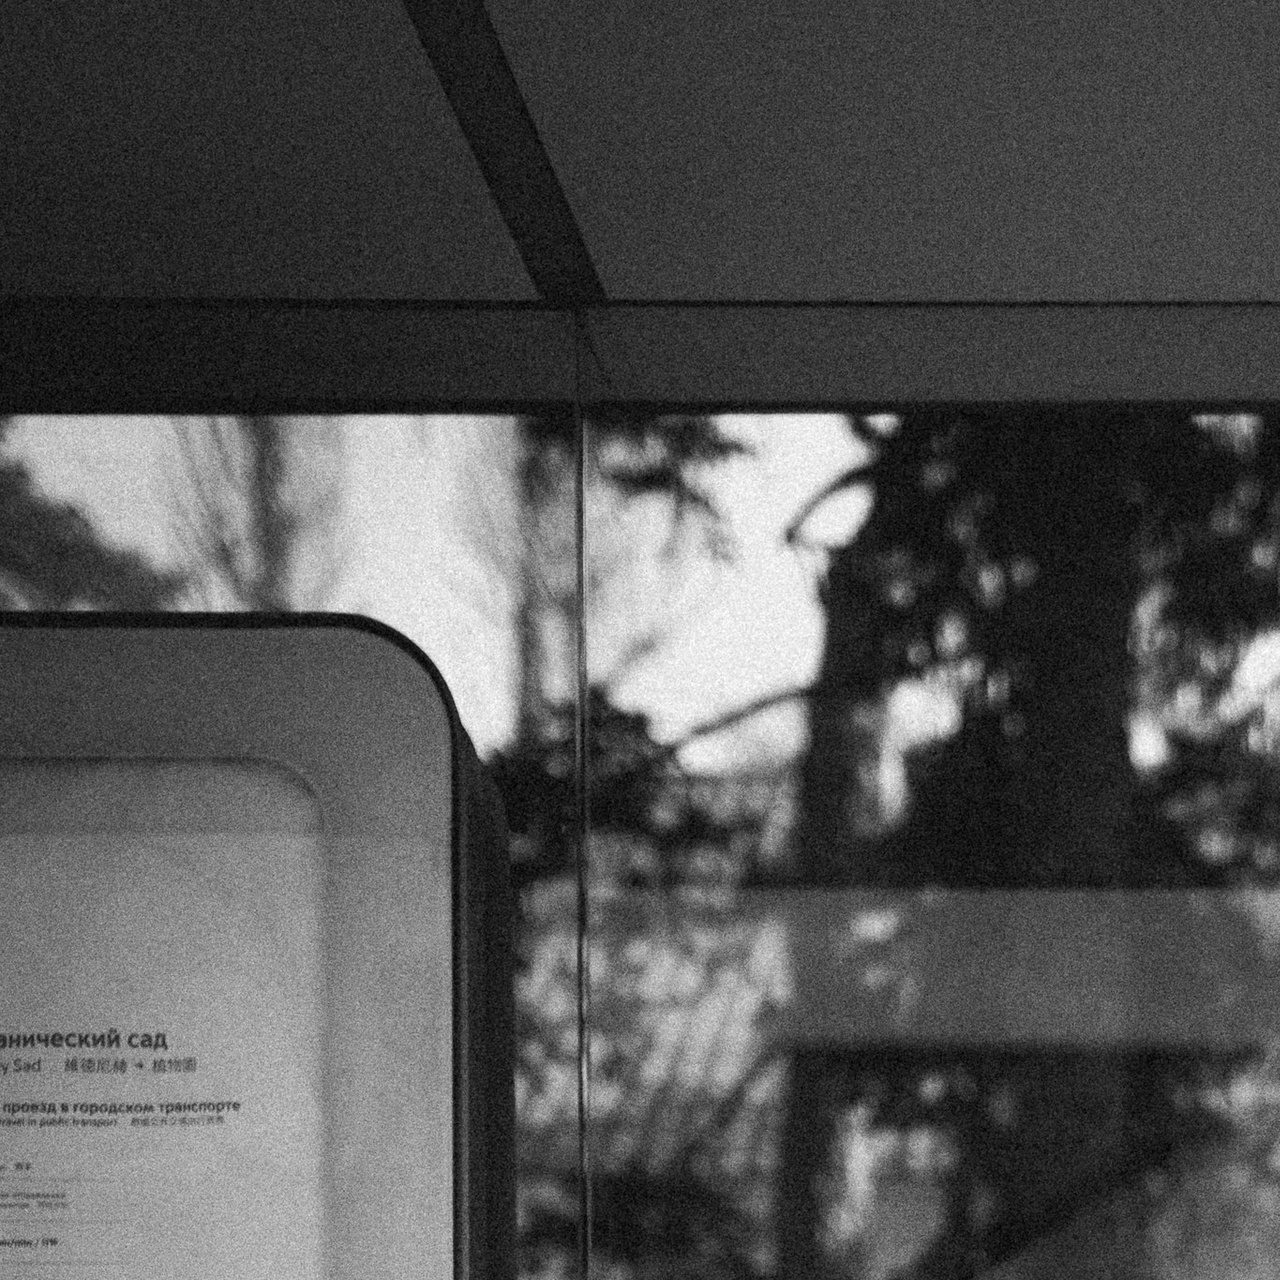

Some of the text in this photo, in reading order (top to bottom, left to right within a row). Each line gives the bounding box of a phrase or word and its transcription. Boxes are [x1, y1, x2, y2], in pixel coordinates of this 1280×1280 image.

[128, 1033, 169, 1051] сад
[13, 1058, 42, 1073] Sad
[3, 1099, 241, 1116] проезд в городском транспорте
